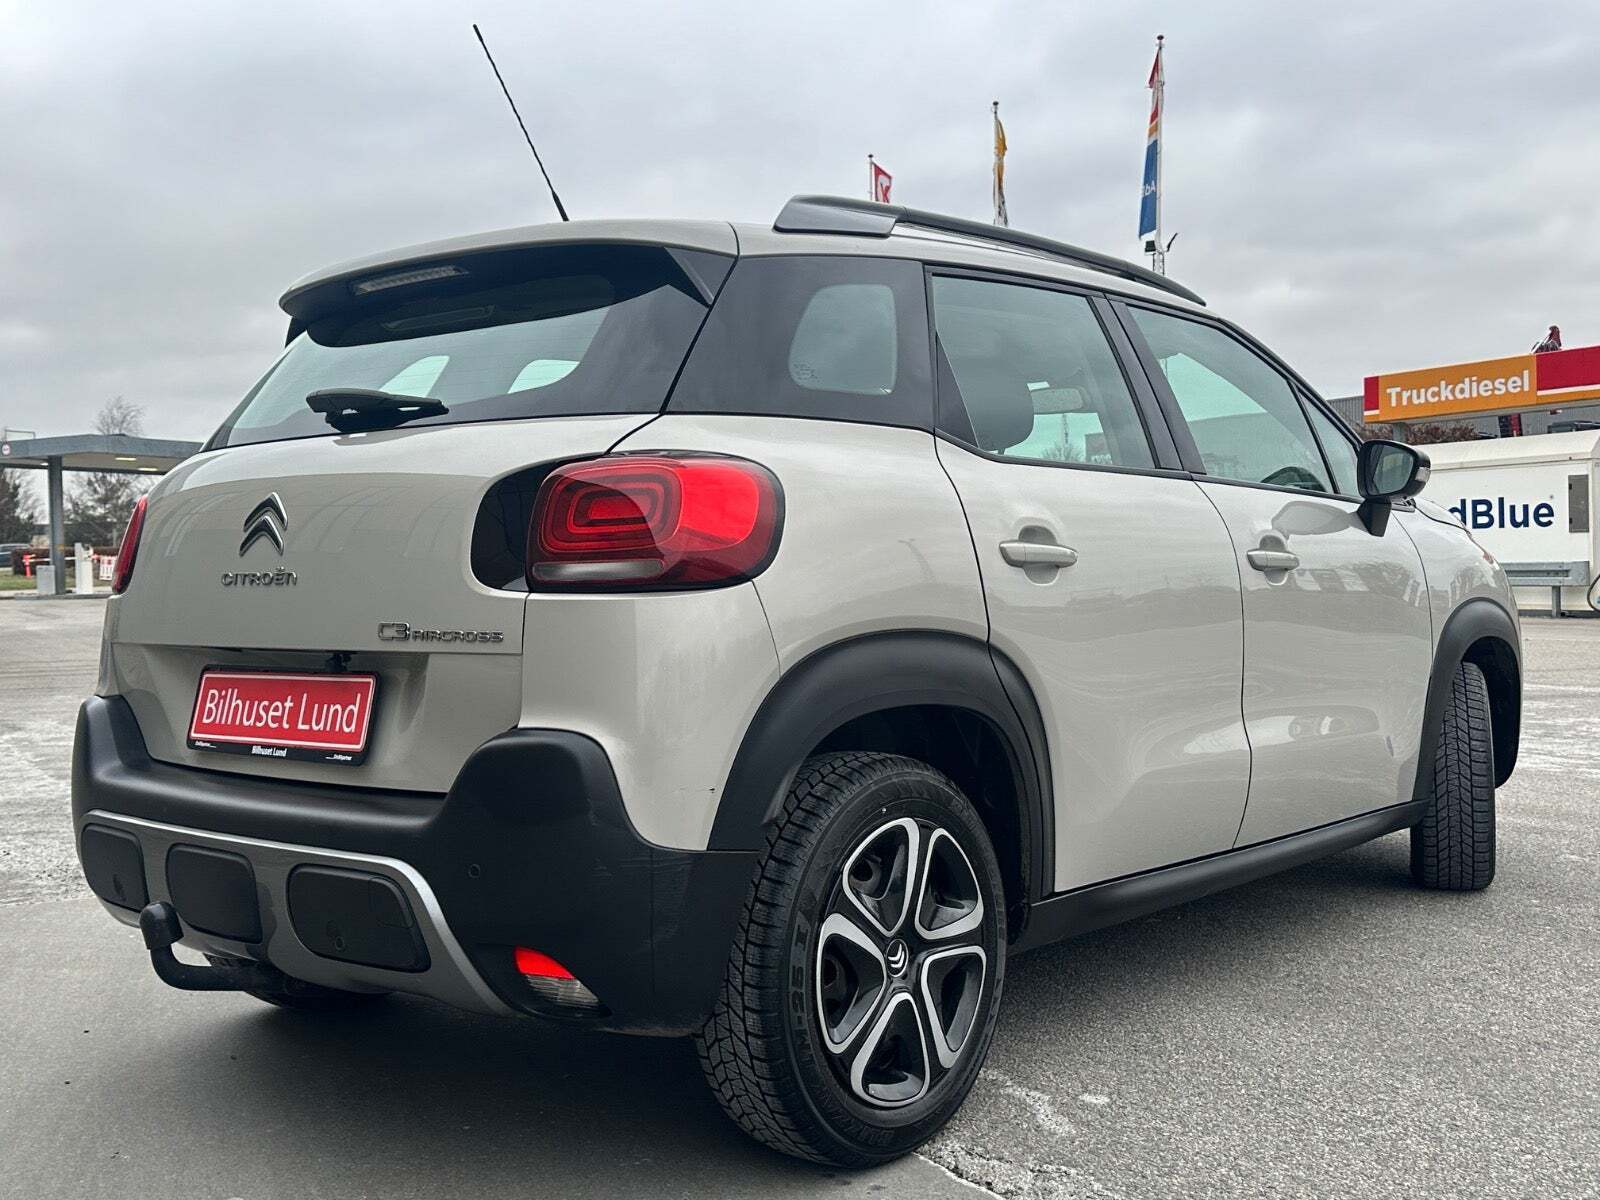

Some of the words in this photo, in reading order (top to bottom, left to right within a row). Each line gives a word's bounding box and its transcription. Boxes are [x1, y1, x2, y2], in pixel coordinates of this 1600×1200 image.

[1386, 370, 1530, 407] Truckdiesel
[1447, 496, 1555, 530] dBlue
[378, 622, 410, 641] C3
[411, 630, 504, 643] AIRCROSS
[202, 688, 294, 729] Bilhuset
[297, 693, 361, 733] Lund
